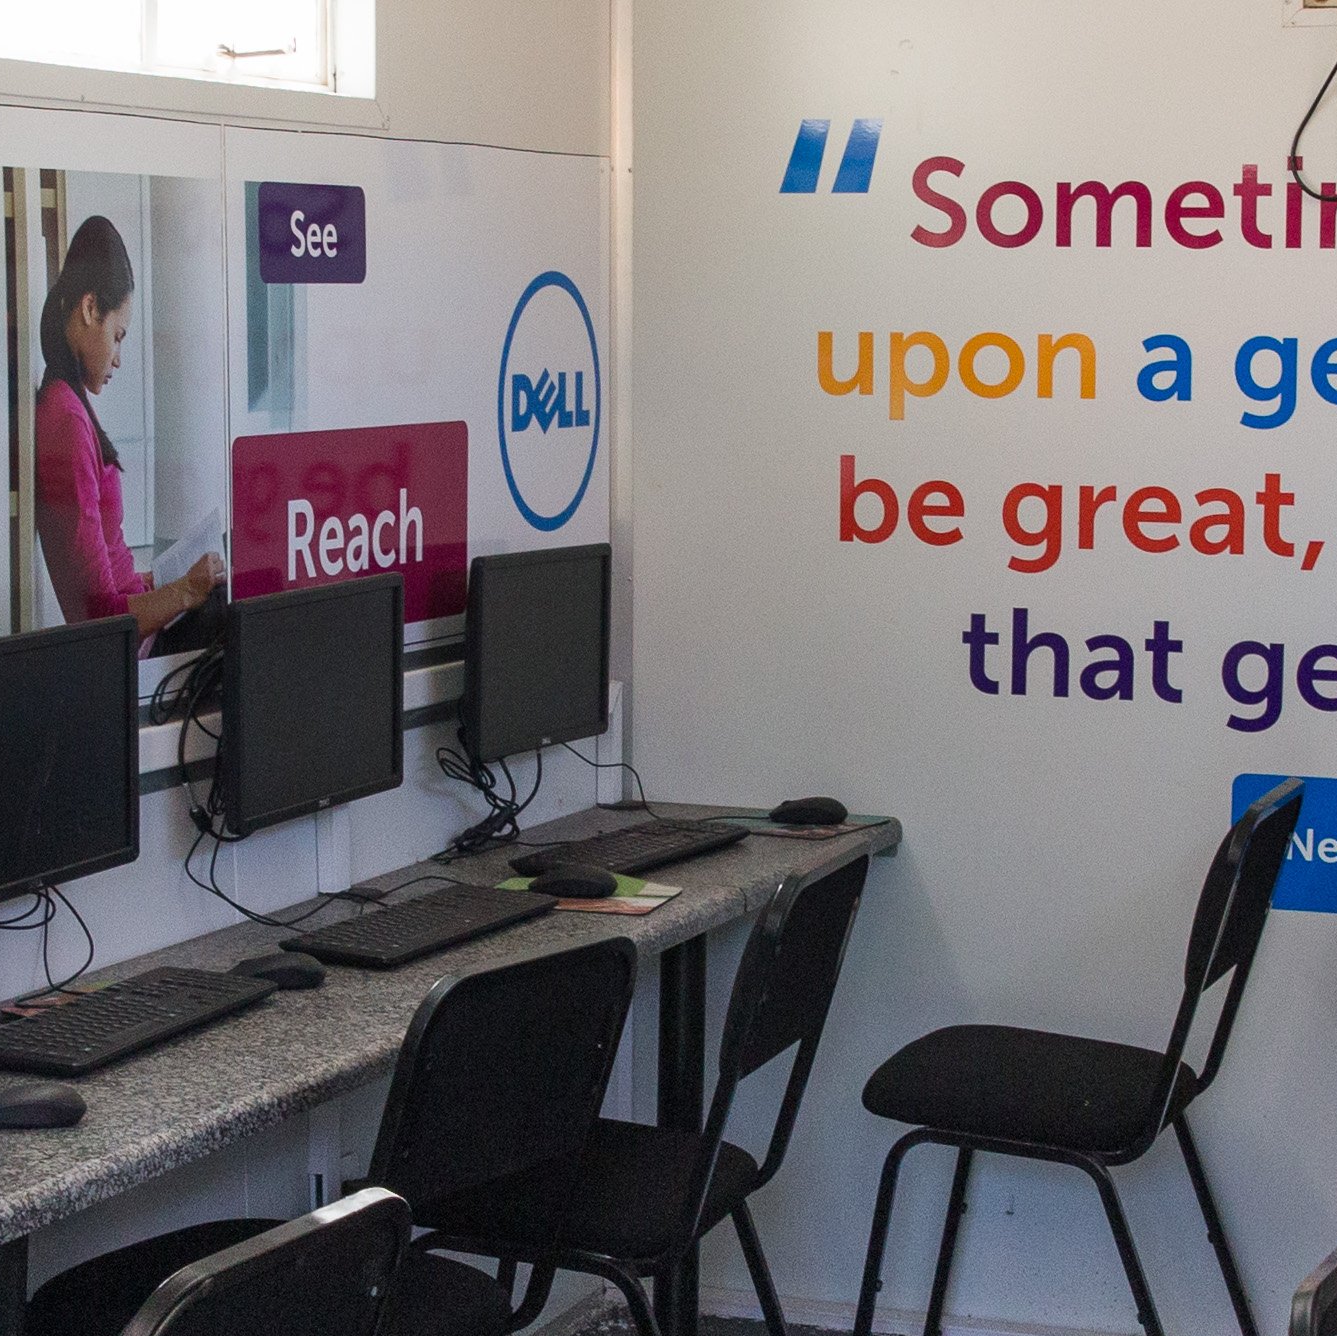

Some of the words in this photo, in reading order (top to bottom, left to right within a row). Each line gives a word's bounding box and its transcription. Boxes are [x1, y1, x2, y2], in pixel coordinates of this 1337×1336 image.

[289, 209, 339, 258] See
[510, 366, 591, 435] DELL
[816, 330, 1098, 421] upon
[1135, 333, 1194, 403] a
[287, 487, 424, 582] Reach
[837, 454, 966, 546] be
[1000, 472, 1326, 574] great,
[961, 607, 1184, 704] that
